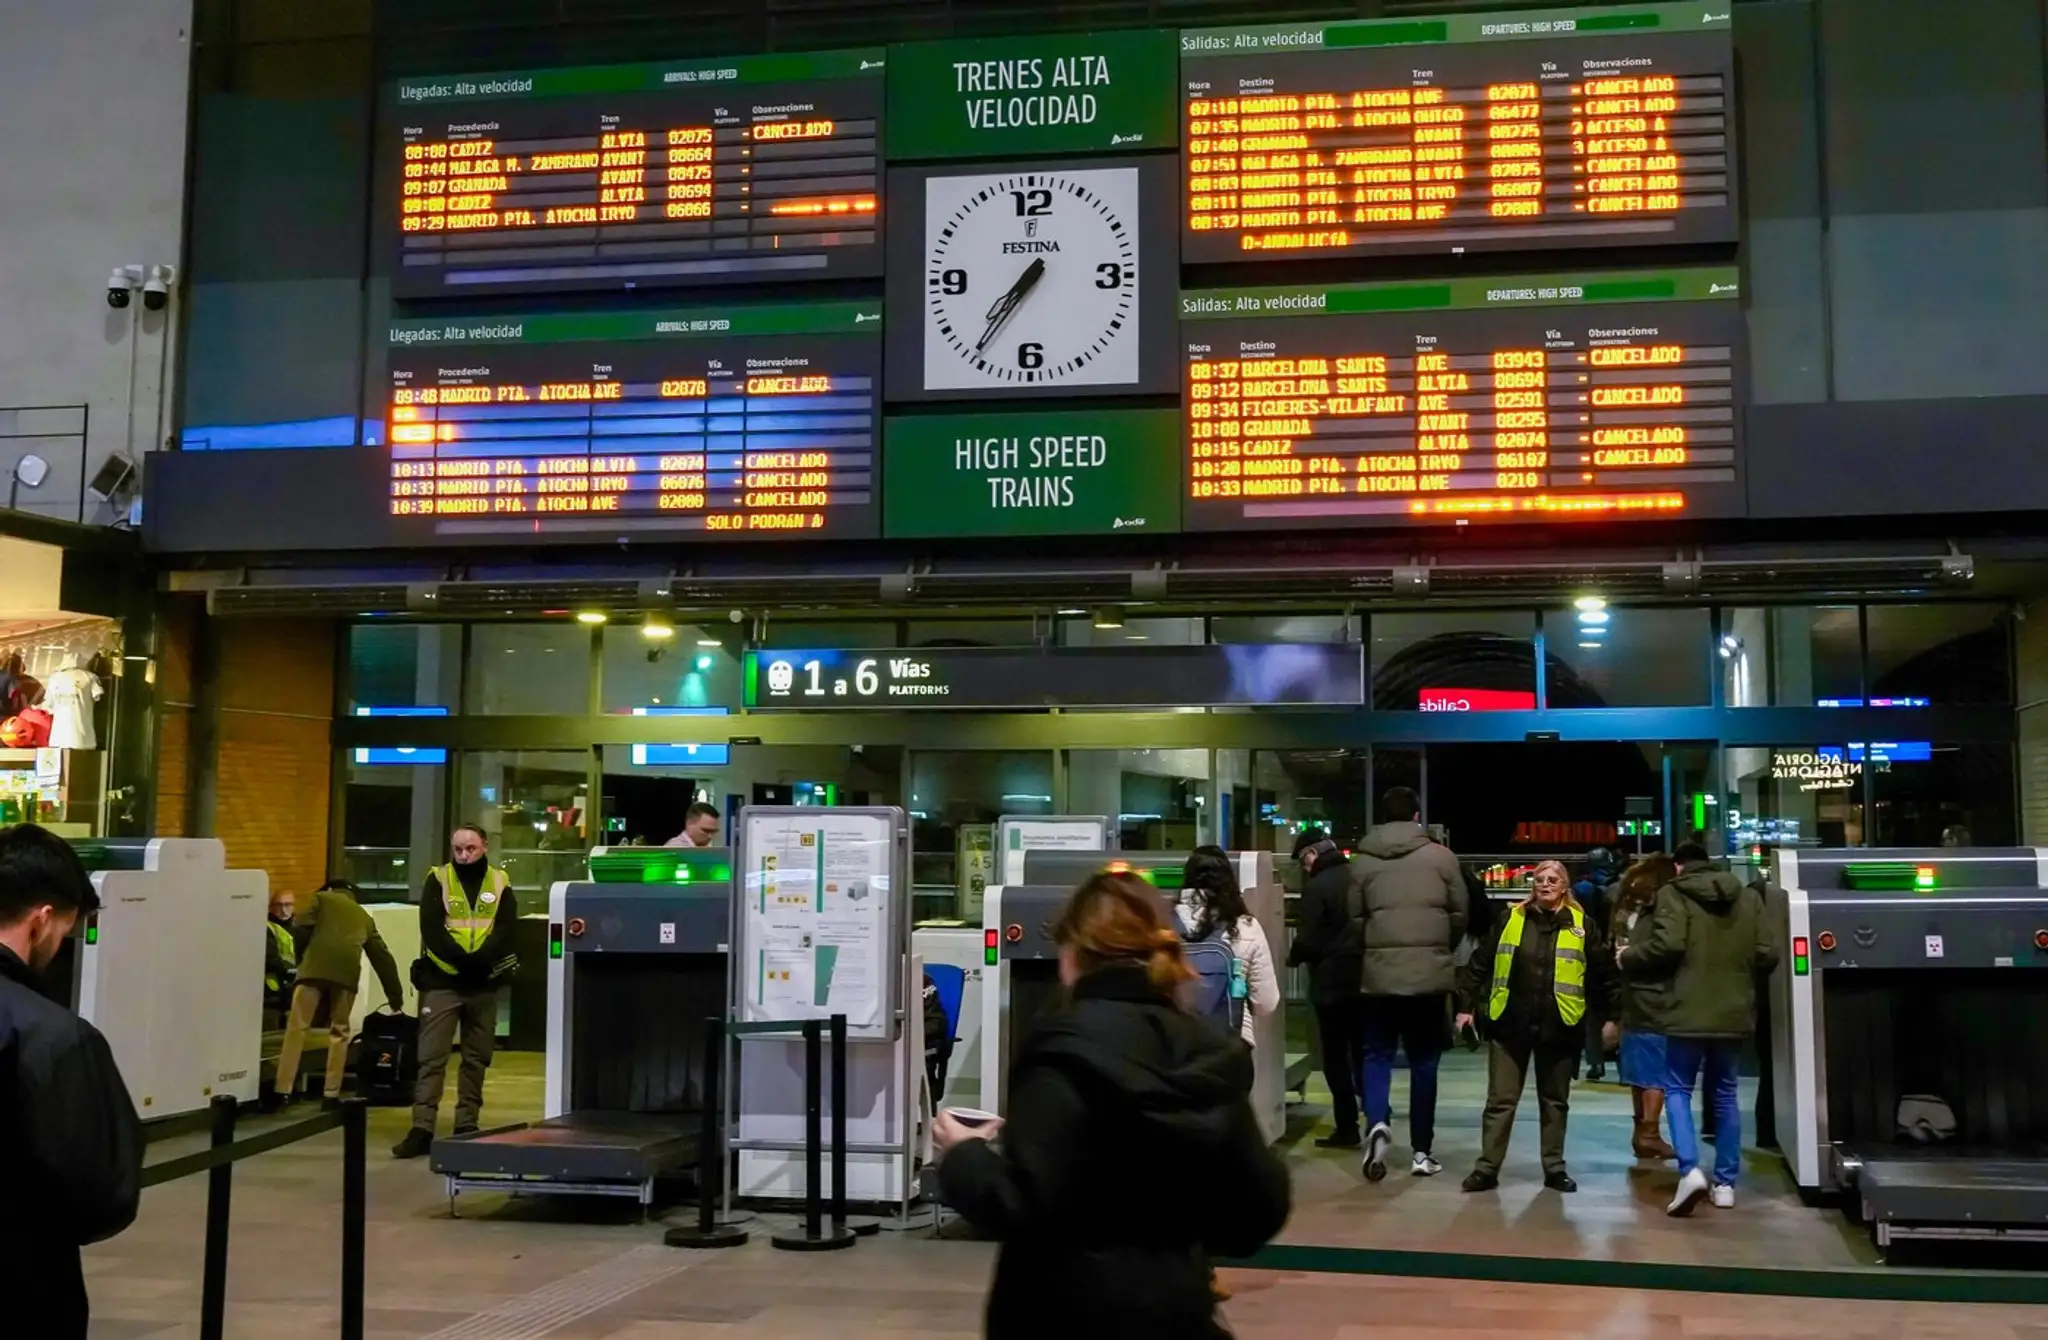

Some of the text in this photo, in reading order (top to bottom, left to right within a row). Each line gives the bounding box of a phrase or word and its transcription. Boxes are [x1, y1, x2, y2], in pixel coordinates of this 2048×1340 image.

[1482, 20, 1576, 34] DEPARTURES: HIGH SPEED
[1182, 31, 1322, 50] Salidas: Alta velocidad
[717, 69, 737, 80] SPEED
[954, 55, 1110, 92] TRENES ALTA
[1189, 81, 1210, 90] Hora
[1239, 78, 1274, 87] Destino
[1413, 69, 1433, 78] Tren
[1583, 58, 1652, 69] Observaciones
[401, 78, 532, 100] Llegadas: Alta velocidad
[448, 122, 499, 133] Procedencia
[752, 104, 814, 115] Observaciones
[966, 94, 1096, 128] VELOCIDAD
[601, 121, 832, 149] ALVIA CANCELADO
[1655, 117, 1665, 131] A
[1655, 137, 1666, 151] A
[531, 153, 599, 171] ZAMBRANO
[601, 151, 645, 167] AVANT
[448, 177, 507, 193] GRANADA
[601, 169, 644, 185] AVANT
[601, 187, 644, 203] ALVIA
[1010, 189, 1052, 216] 12
[447, 213, 498, 229] MADRID
[504, 211, 536, 225] PTA.
[546, 208, 597, 224] ATOCHA
[601, 206, 635, 221] IRYO
[1002, 241, 1061, 254] FESTINA
[942, 263, 1121, 295] 9 3
[1183, 294, 1325, 313] Salidas: Alta velocidad
[1487, 287, 1583, 300] DEPARTURES: HIGH SPEED
[390, 324, 522, 344] Llegadas: Alta velocidad
[690, 320, 707, 331] HIGH
[709, 319, 730, 330] SPEED
[1189, 343, 1210, 352] Hora
[1240, 341, 1275, 350] Destino
[1416, 335, 1437, 344] Tren
[1588, 327, 1659, 337] Observaciones
[1018, 342, 1044, 369] 6
[1242, 360, 1328, 378] BARCELONA
[1336, 357, 1385, 374] SANTS
[1417, 355, 1447, 371] AVE
[1494, 352, 1544, 368] 03943
[1591, 347, 1681, 365] CANCELADO
[393, 370, 413, 379] Hora
[438, 366, 490, 377] Procedencia
[746, 358, 809, 368] Observaciones
[440, 387, 491, 403] MADRID
[498, 386, 530, 401] PTA.
[540, 384, 590, 400] ATOCHA
[593, 383, 621, 399] AVE
[1192, 375, 1468, 398] 09:12 BARCELONA SANTS ALVIA
[1192, 403, 1239, 418] 09:34
[1243, 396, 1405, 416] FIGUERES-VILAFANT
[1418, 395, 1448, 411] AVE
[1592, 387, 1682, 405] CANCELADO
[1243, 415, 1468, 436] GRANADA AVANT
[955, 435, 1106, 469] HIGH SPEED
[1192, 442, 1240, 457] 10:15
[1419, 435, 1468, 450] ALVIA
[1593, 427, 1684, 445] CANCELADO
[392, 453, 827, 477] 10:13 MADRID PTA. ATOCHA ALVIA CANCELADO
[1243, 447, 1685, 475] MADRID PTA. ATOCHA IRYO CANCELADO
[392, 472, 827, 496] 10:33 MADRID PTA. ATOCHA IRYO CANCELADO
[988, 476, 1074, 508] TRAINS
[1192, 475, 1449, 496] 10:33 MADRID PTA. ATOCHA AVE
[391, 491, 827, 514] 10:39 MADRID PTA. ATOCHA AVE CANCELADO
[706, 515, 742, 530] SOLO
[804, 658, 930, 695] 1 a 6 Vías
[889, 684, 949, 695] PLATFORMS
[1729, 810, 1740, 828] 3
